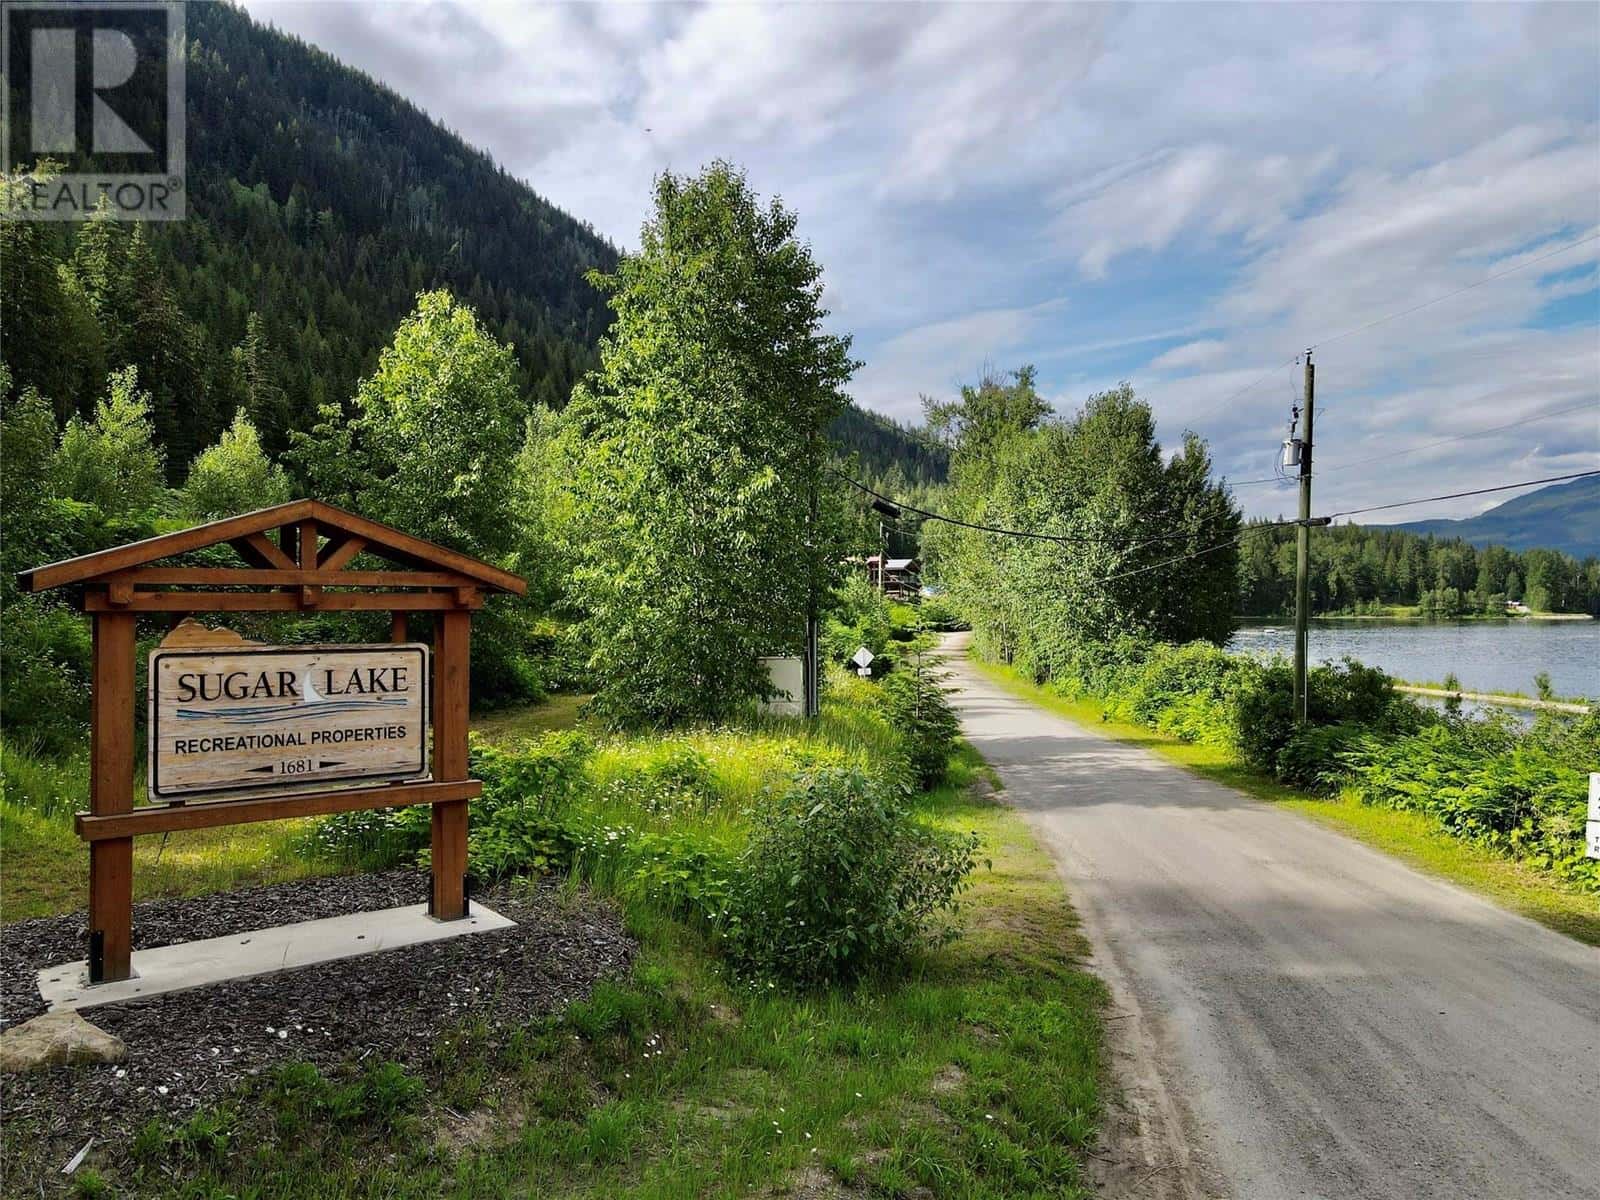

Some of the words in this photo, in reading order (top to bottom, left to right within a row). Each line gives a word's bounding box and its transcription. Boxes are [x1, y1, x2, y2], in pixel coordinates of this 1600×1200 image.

[177, 671, 299, 703] SUGAR
[324, 667, 409, 696] LAKE
[175, 732, 306, 754] RECREATIONAL
[311, 725, 407, 745] PROPERTIES
[279, 759, 313, 774] 1681
